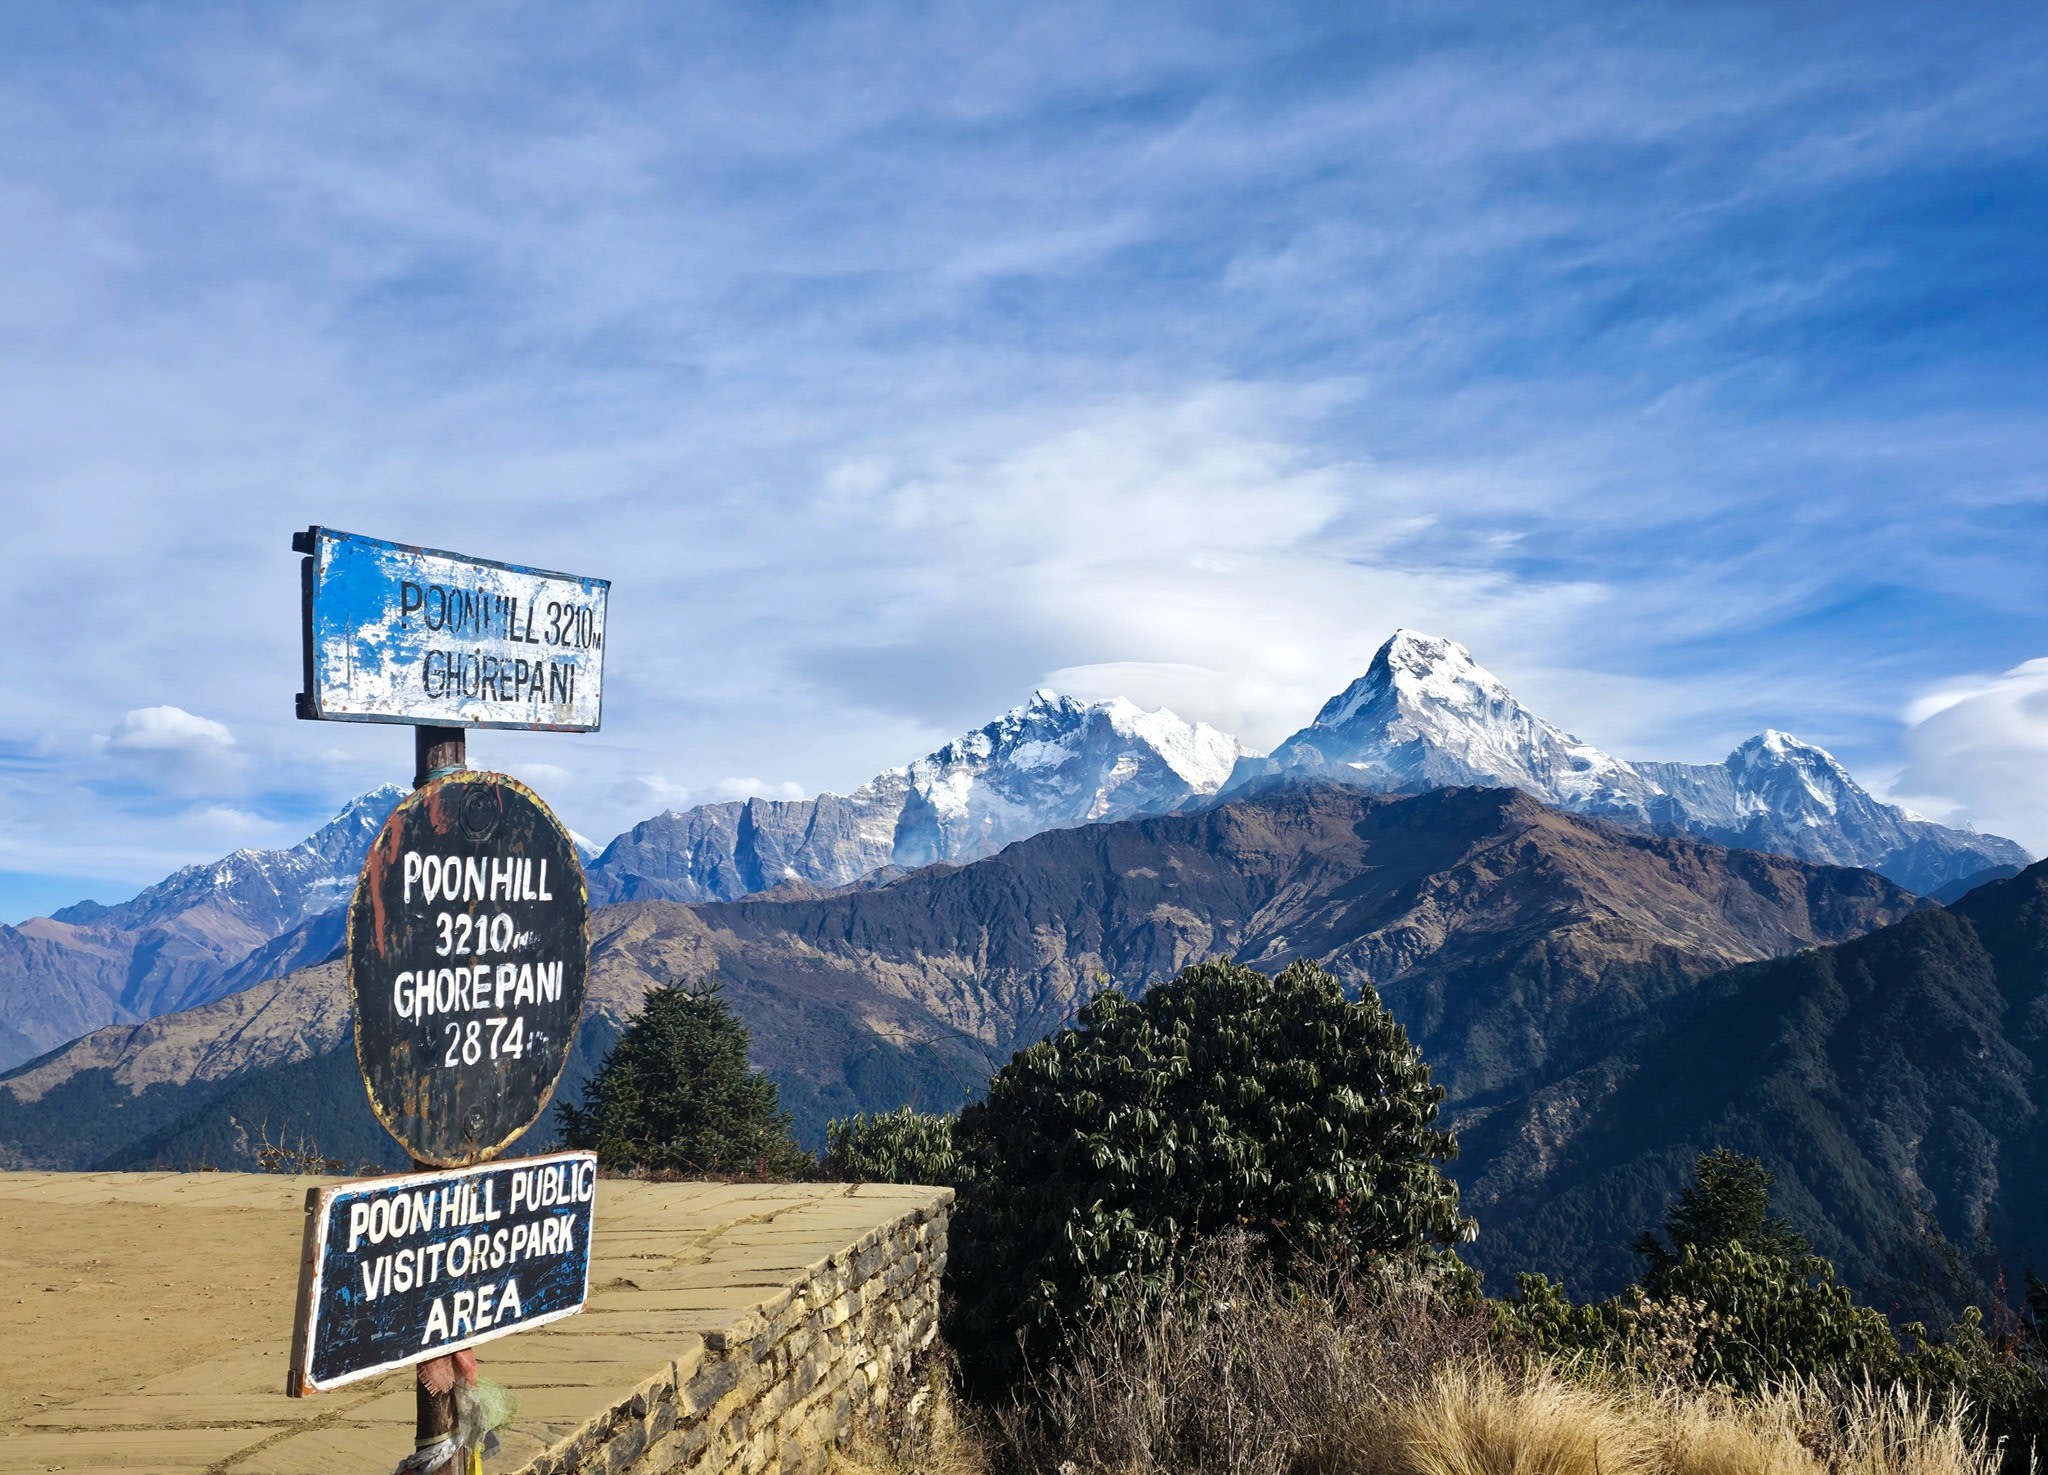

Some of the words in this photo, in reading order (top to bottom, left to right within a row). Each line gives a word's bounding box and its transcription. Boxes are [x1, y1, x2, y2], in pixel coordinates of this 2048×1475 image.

[422, 649, 575, 704] GHOREPANI
[510, 1161, 593, 1215] PUBLIC
[421, 1278, 522, 1345] AREA
